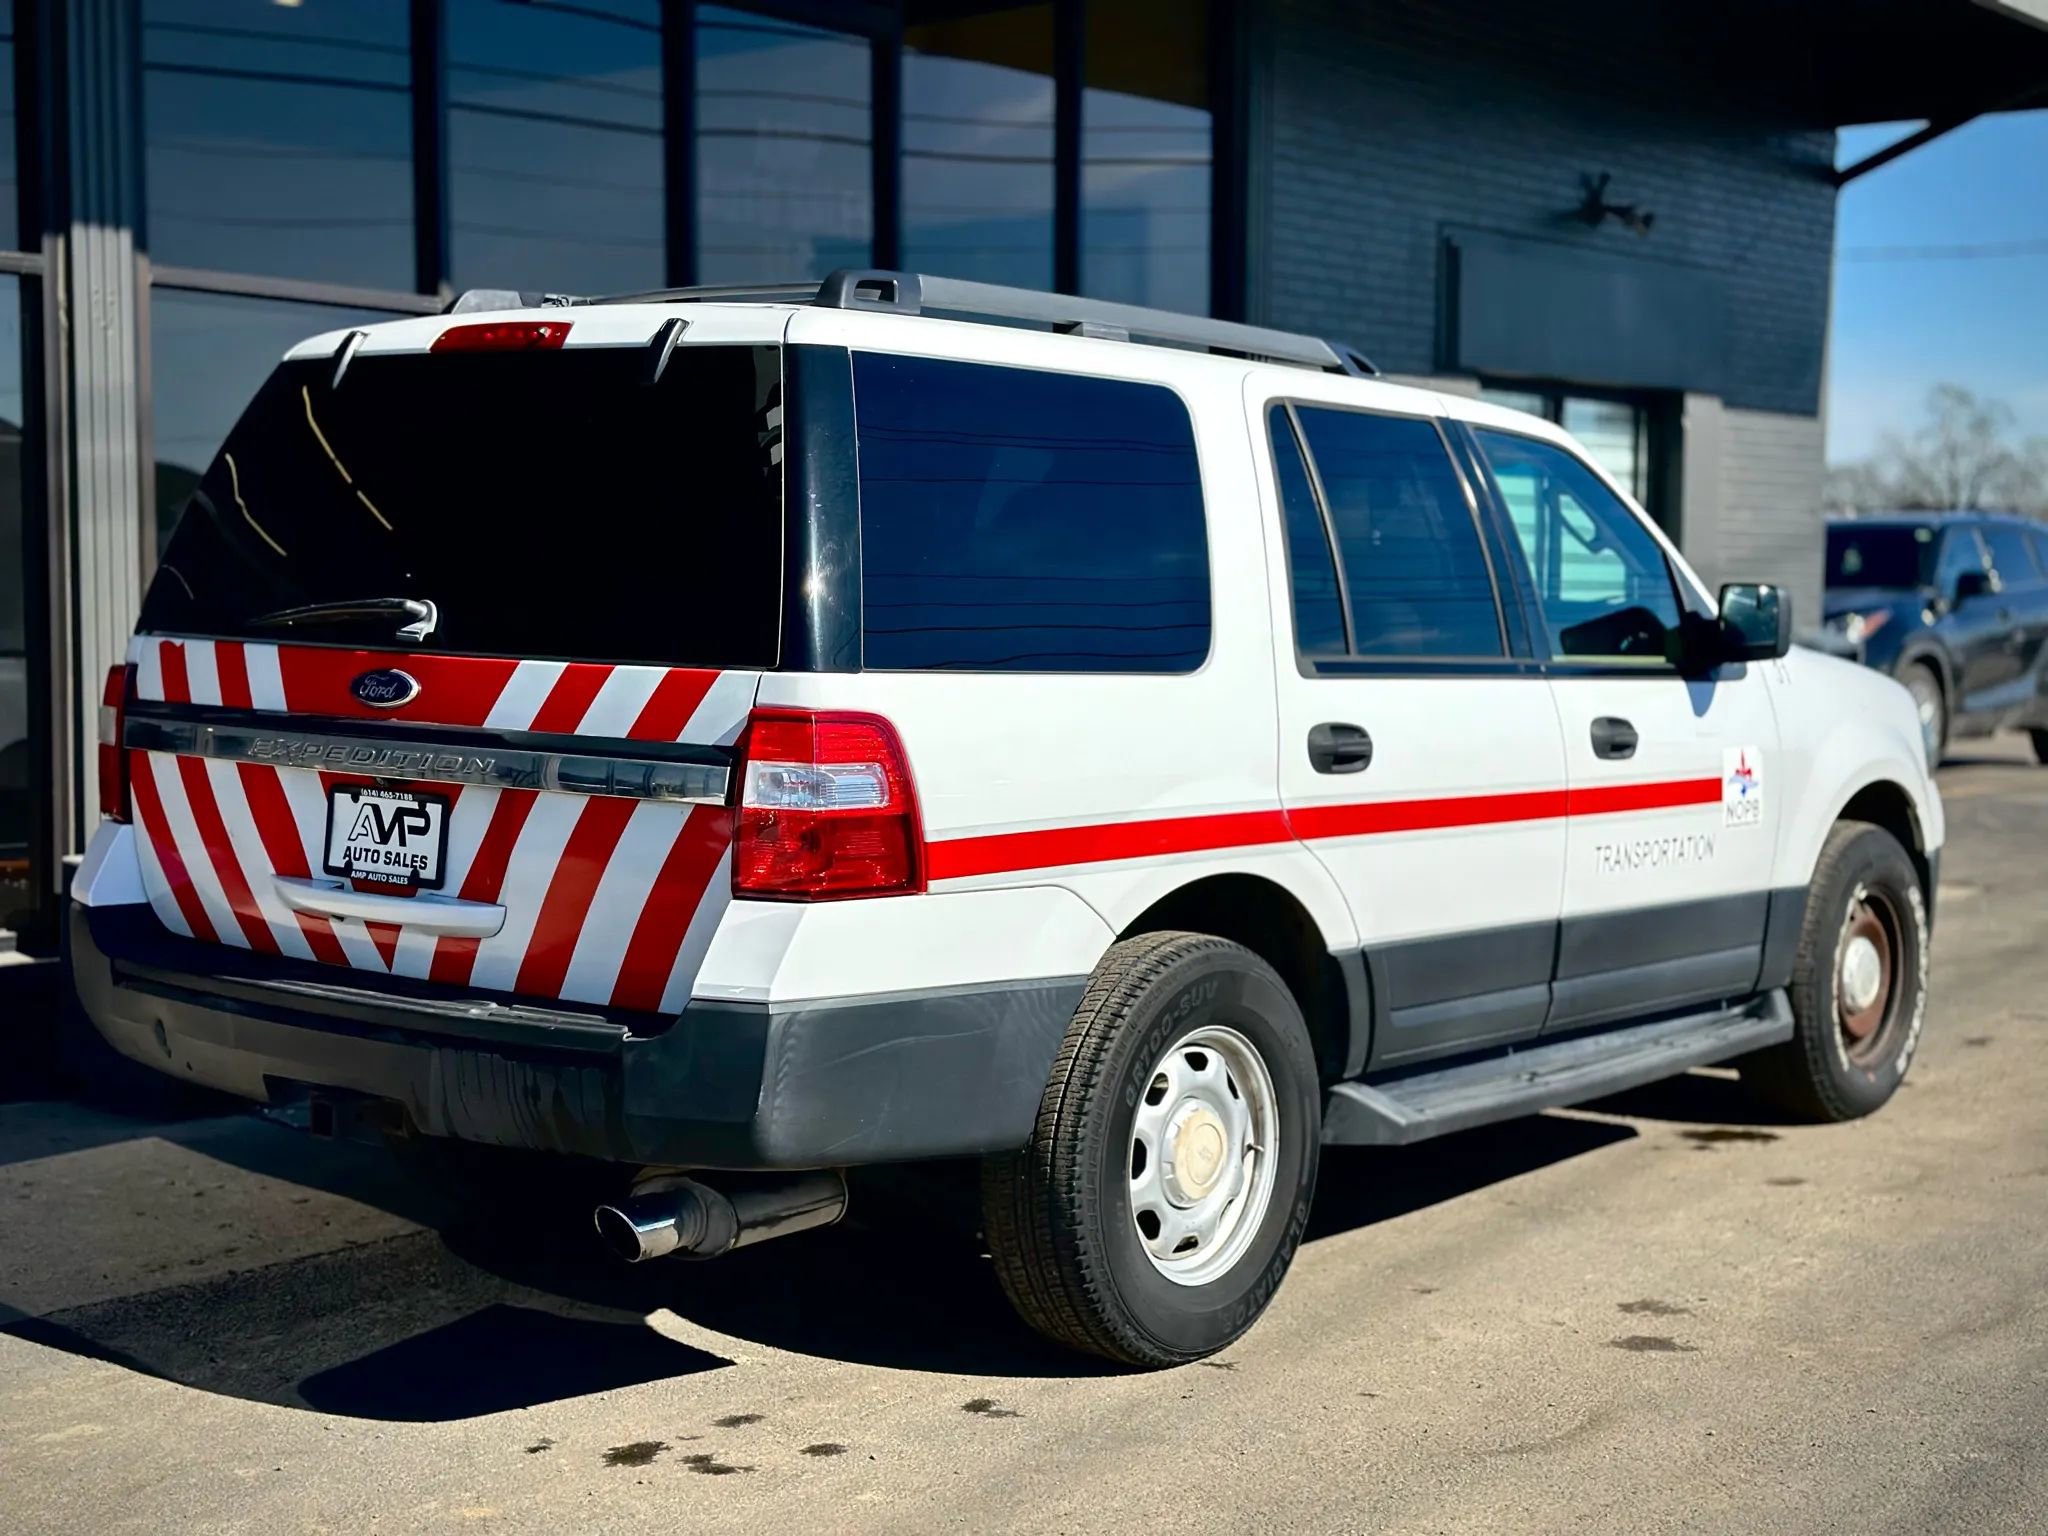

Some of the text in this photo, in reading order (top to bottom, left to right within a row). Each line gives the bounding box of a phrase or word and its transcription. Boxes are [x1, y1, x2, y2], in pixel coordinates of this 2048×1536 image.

[360, 674, 398, 699] Ford
[248, 737, 498, 777] EXPEDITION
[361, 788, 379, 797] (614)
[343, 846, 428, 871] AUTO SALES
[1594, 832, 1717, 874] TRANSPORTATION
[351, 870, 408, 885] AMP AUTO SALES
